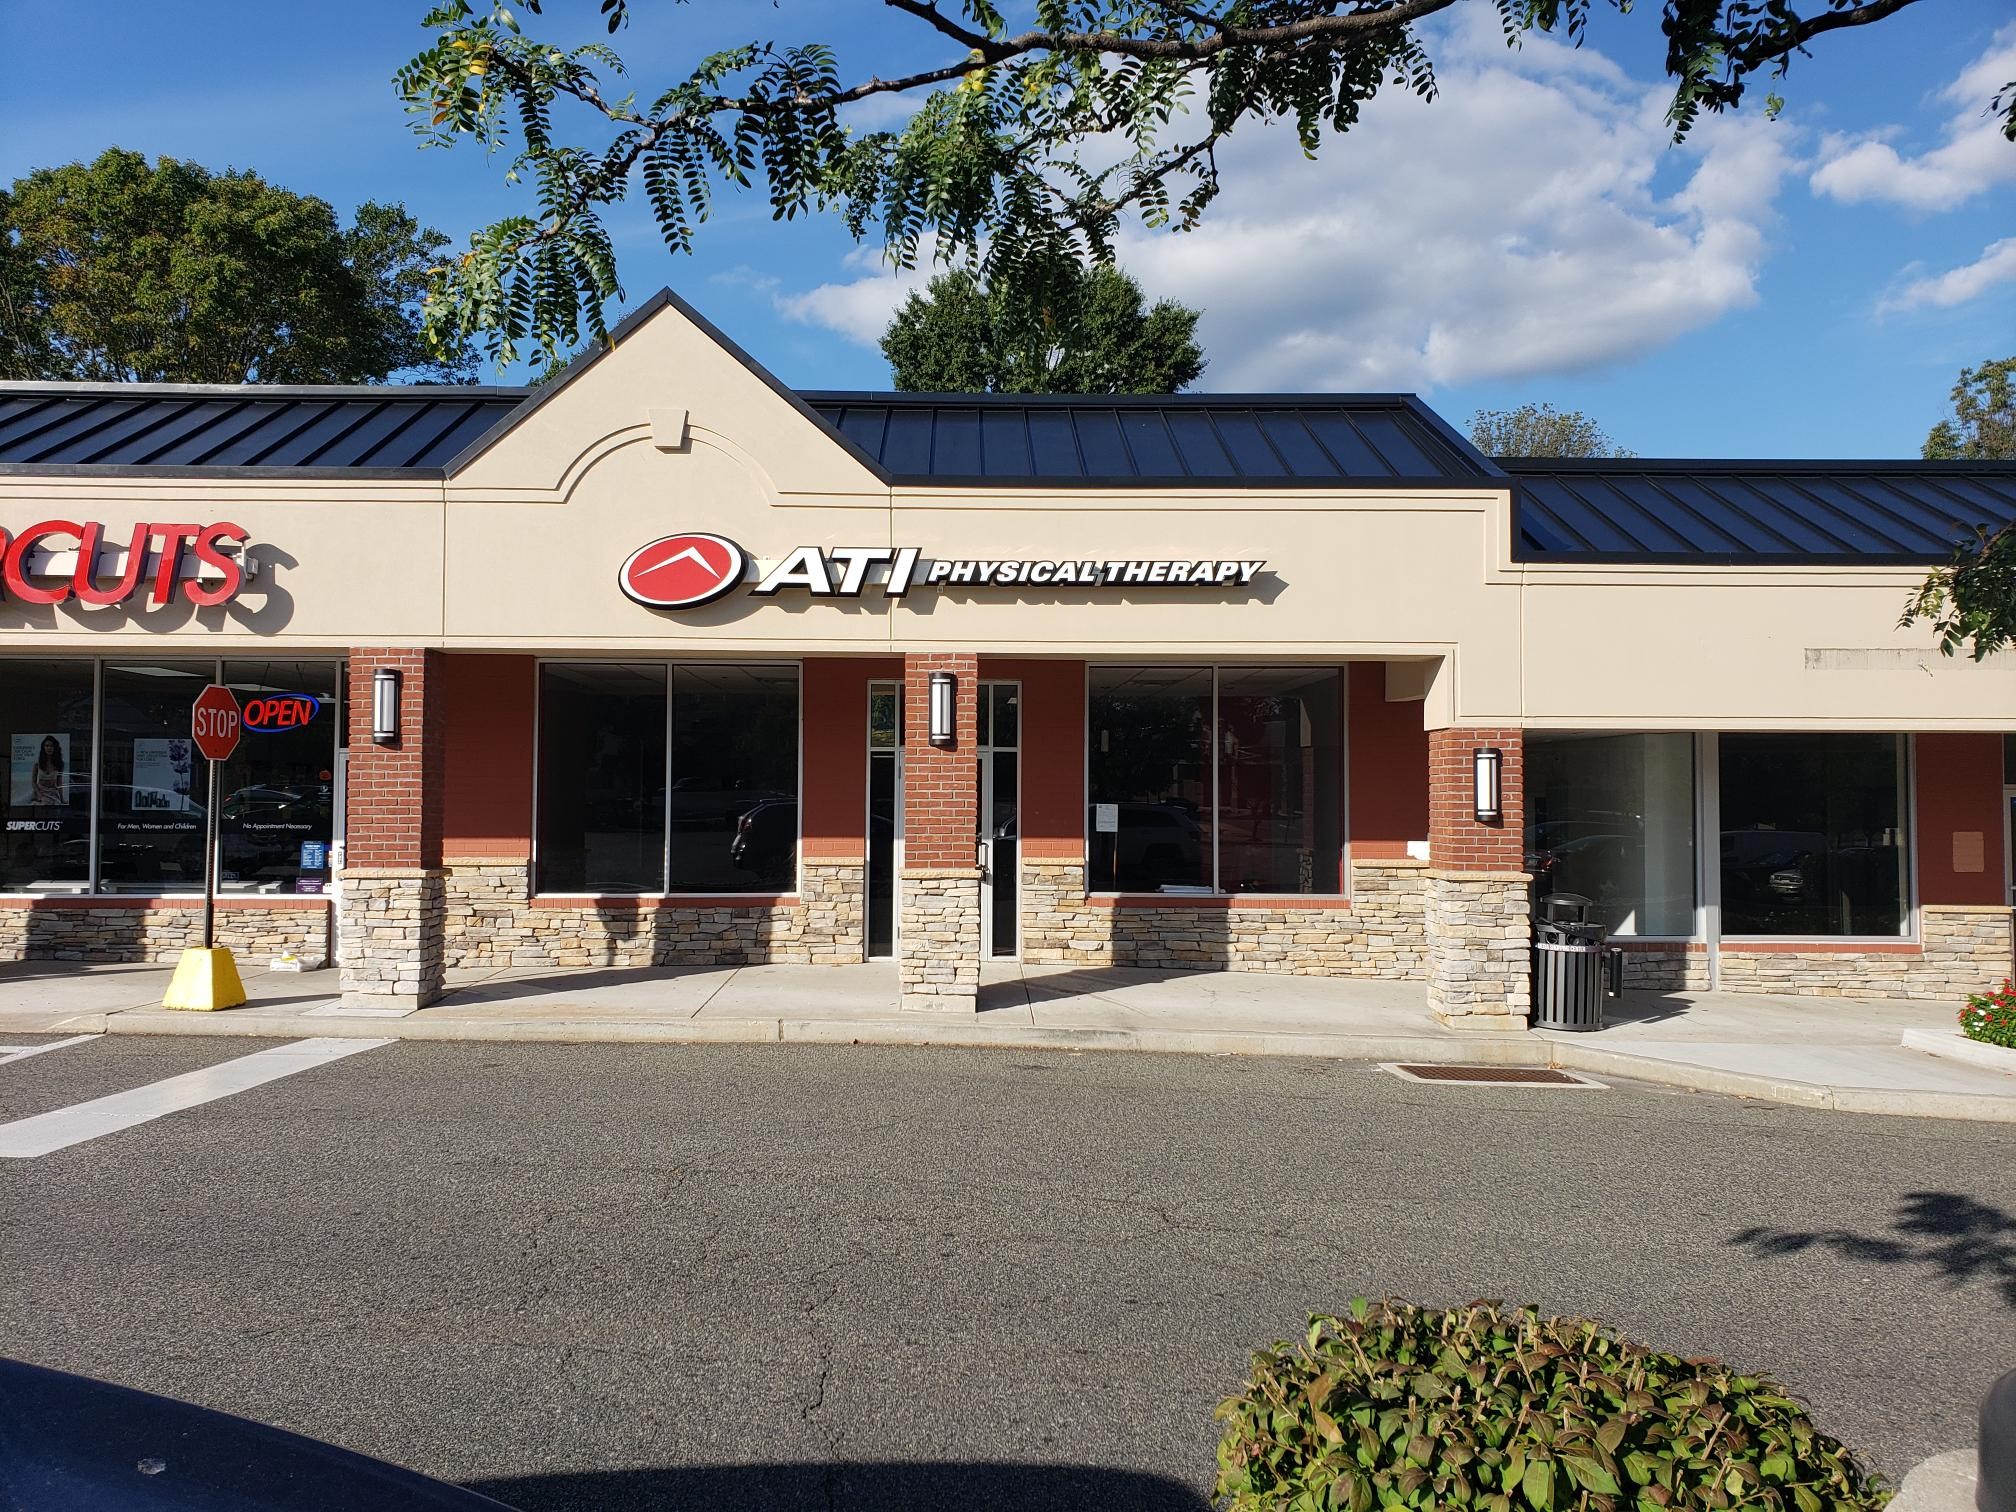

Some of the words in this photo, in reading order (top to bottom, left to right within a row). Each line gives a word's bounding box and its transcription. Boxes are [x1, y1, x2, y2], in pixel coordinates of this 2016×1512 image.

[0, 520, 250, 606] CUTS
[748, 546, 922, 598] ATI
[927, 560, 1099, 587] PHYSICAL
[1101, 560, 1267, 587] THERAPY
[196, 707, 238, 738] STOP
[243, 699, 312, 726] OPEN
[6, 820, 61, 831] SUPERCUTS
[163, 822, 175, 830] and
[175, 822, 197, 830] Children
[252, 822, 285, 831] Appointment
[285, 822, 313, 831] Necessary
